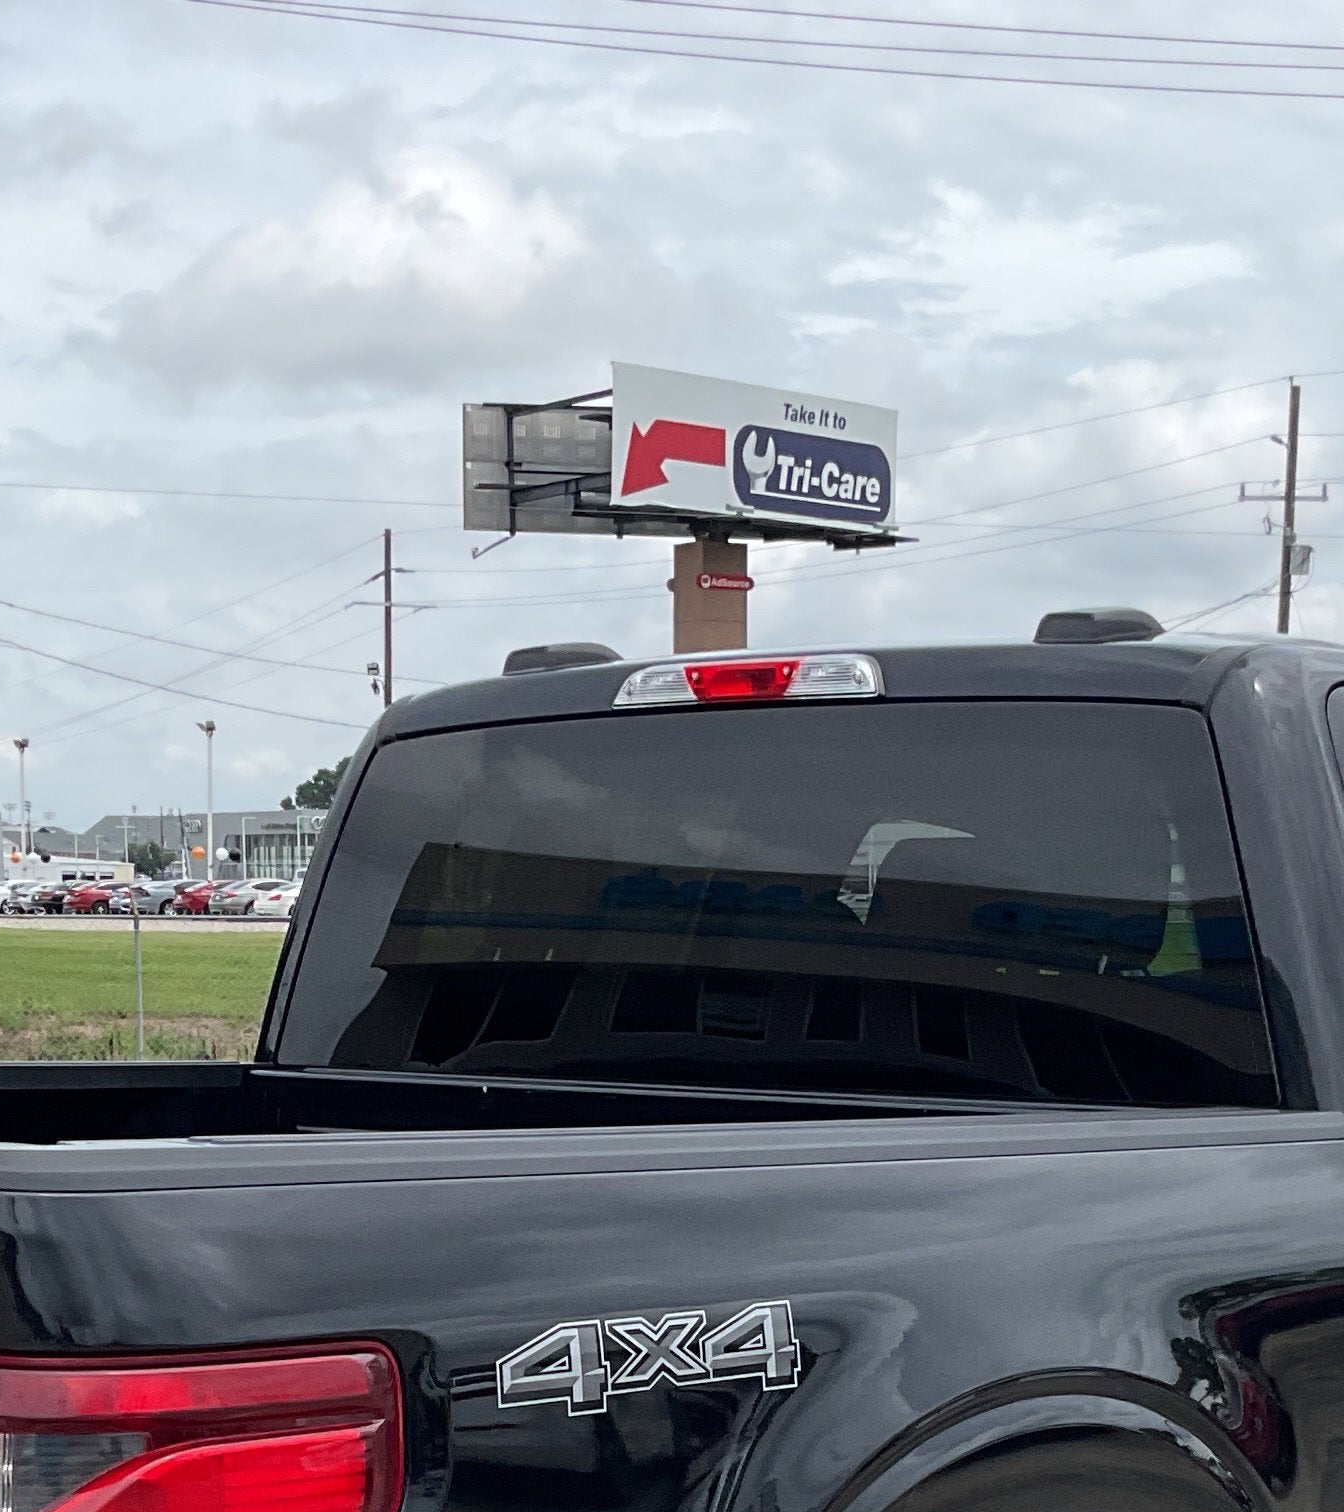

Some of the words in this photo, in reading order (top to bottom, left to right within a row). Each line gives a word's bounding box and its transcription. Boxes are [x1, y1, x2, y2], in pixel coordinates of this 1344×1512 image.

[783, 402, 816, 426] Take
[819, 408, 830, 429] It
[833, 412, 846, 430] to
[777, 455, 880, 503] Tri-Care
